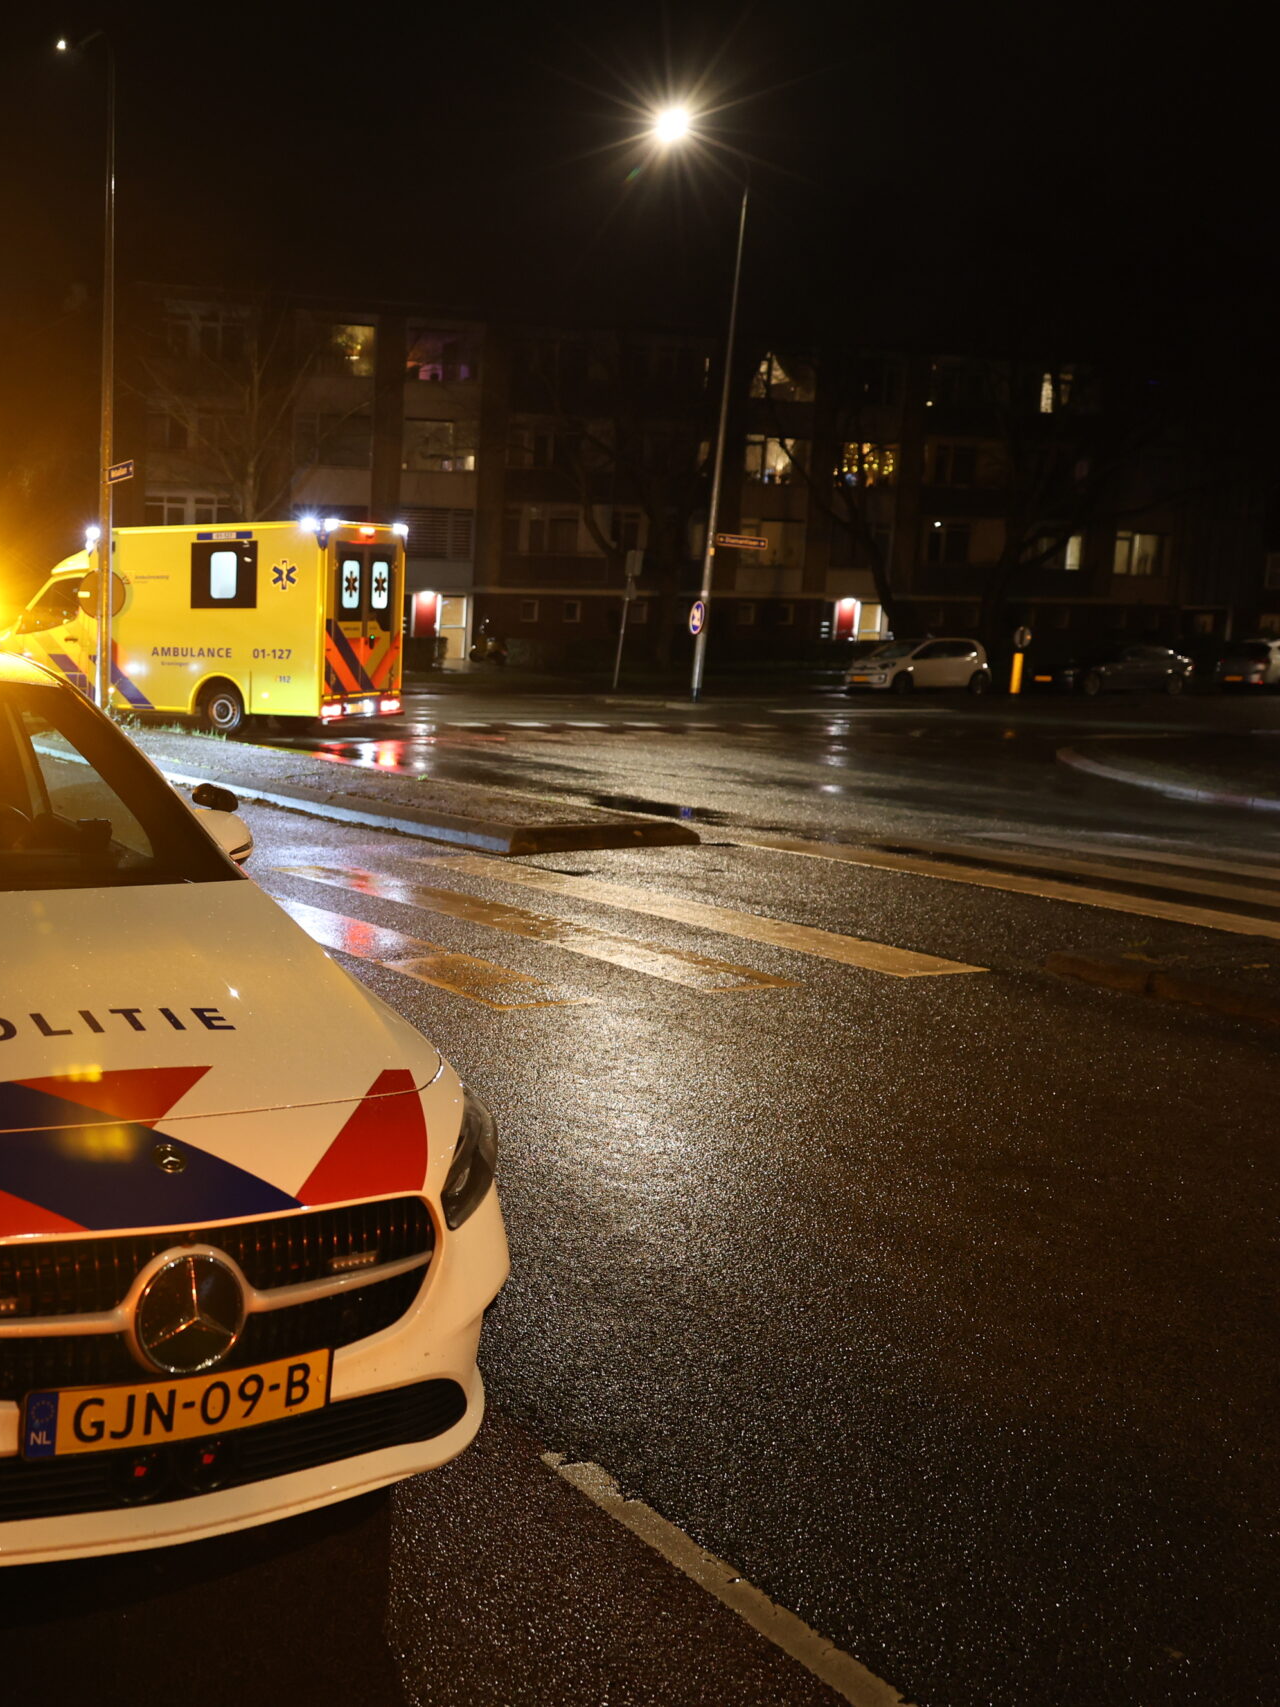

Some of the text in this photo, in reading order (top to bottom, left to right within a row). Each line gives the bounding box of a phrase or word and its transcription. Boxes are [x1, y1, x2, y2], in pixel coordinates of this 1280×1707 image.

[151, 646, 292, 660] AMBULANCE 01-127
[72, 1362, 311, 1443] GJN-09-B
[29, 1430, 51, 1446] NL
